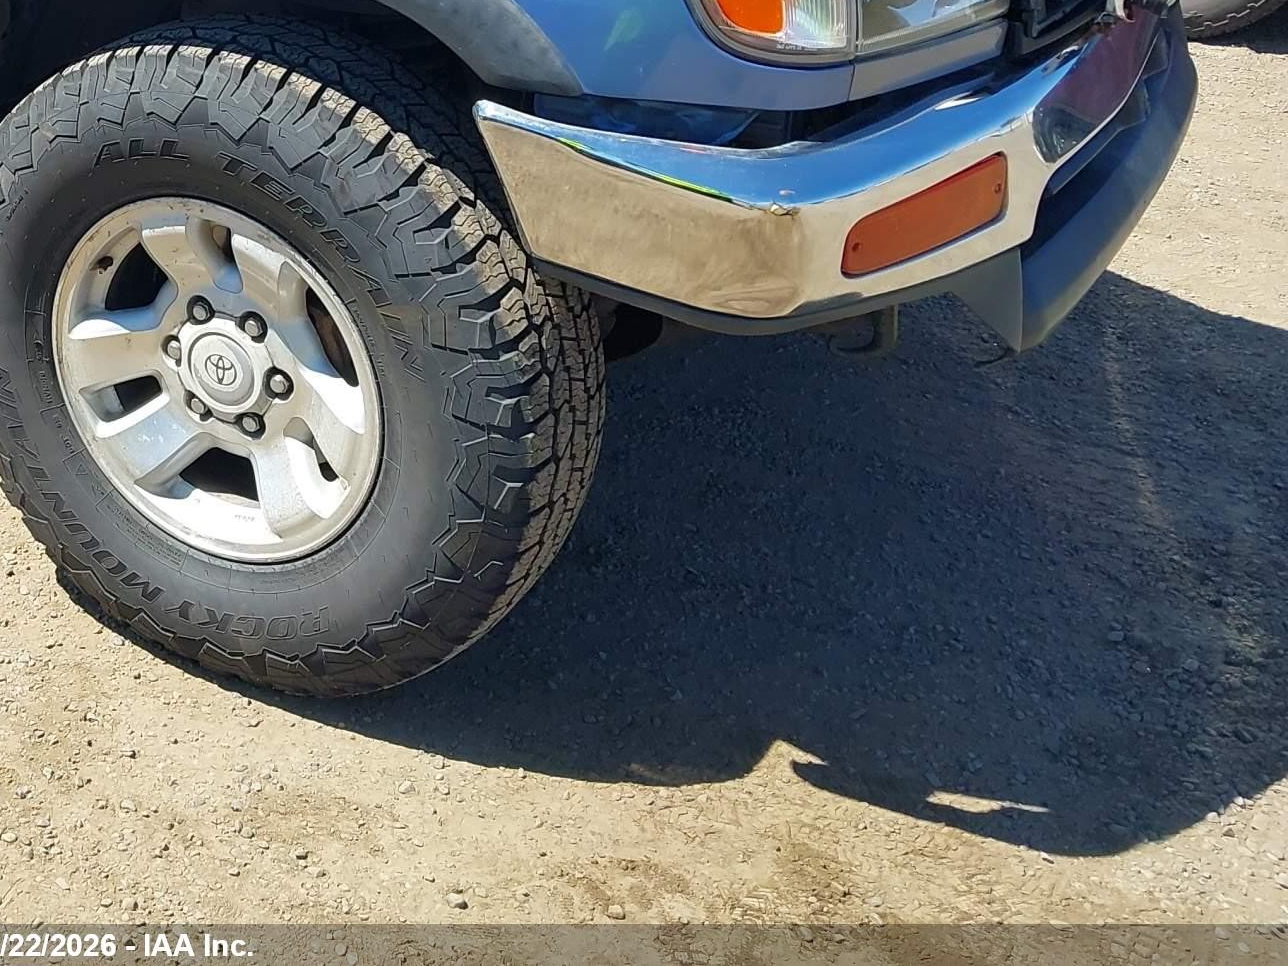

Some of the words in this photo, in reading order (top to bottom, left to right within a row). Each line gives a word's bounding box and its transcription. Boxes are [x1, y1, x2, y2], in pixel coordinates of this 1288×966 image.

[91, 138, 191, 176] ALL
[216, 151, 426, 382] TERRAIN
[163, 599, 330, 642] ROCKY
